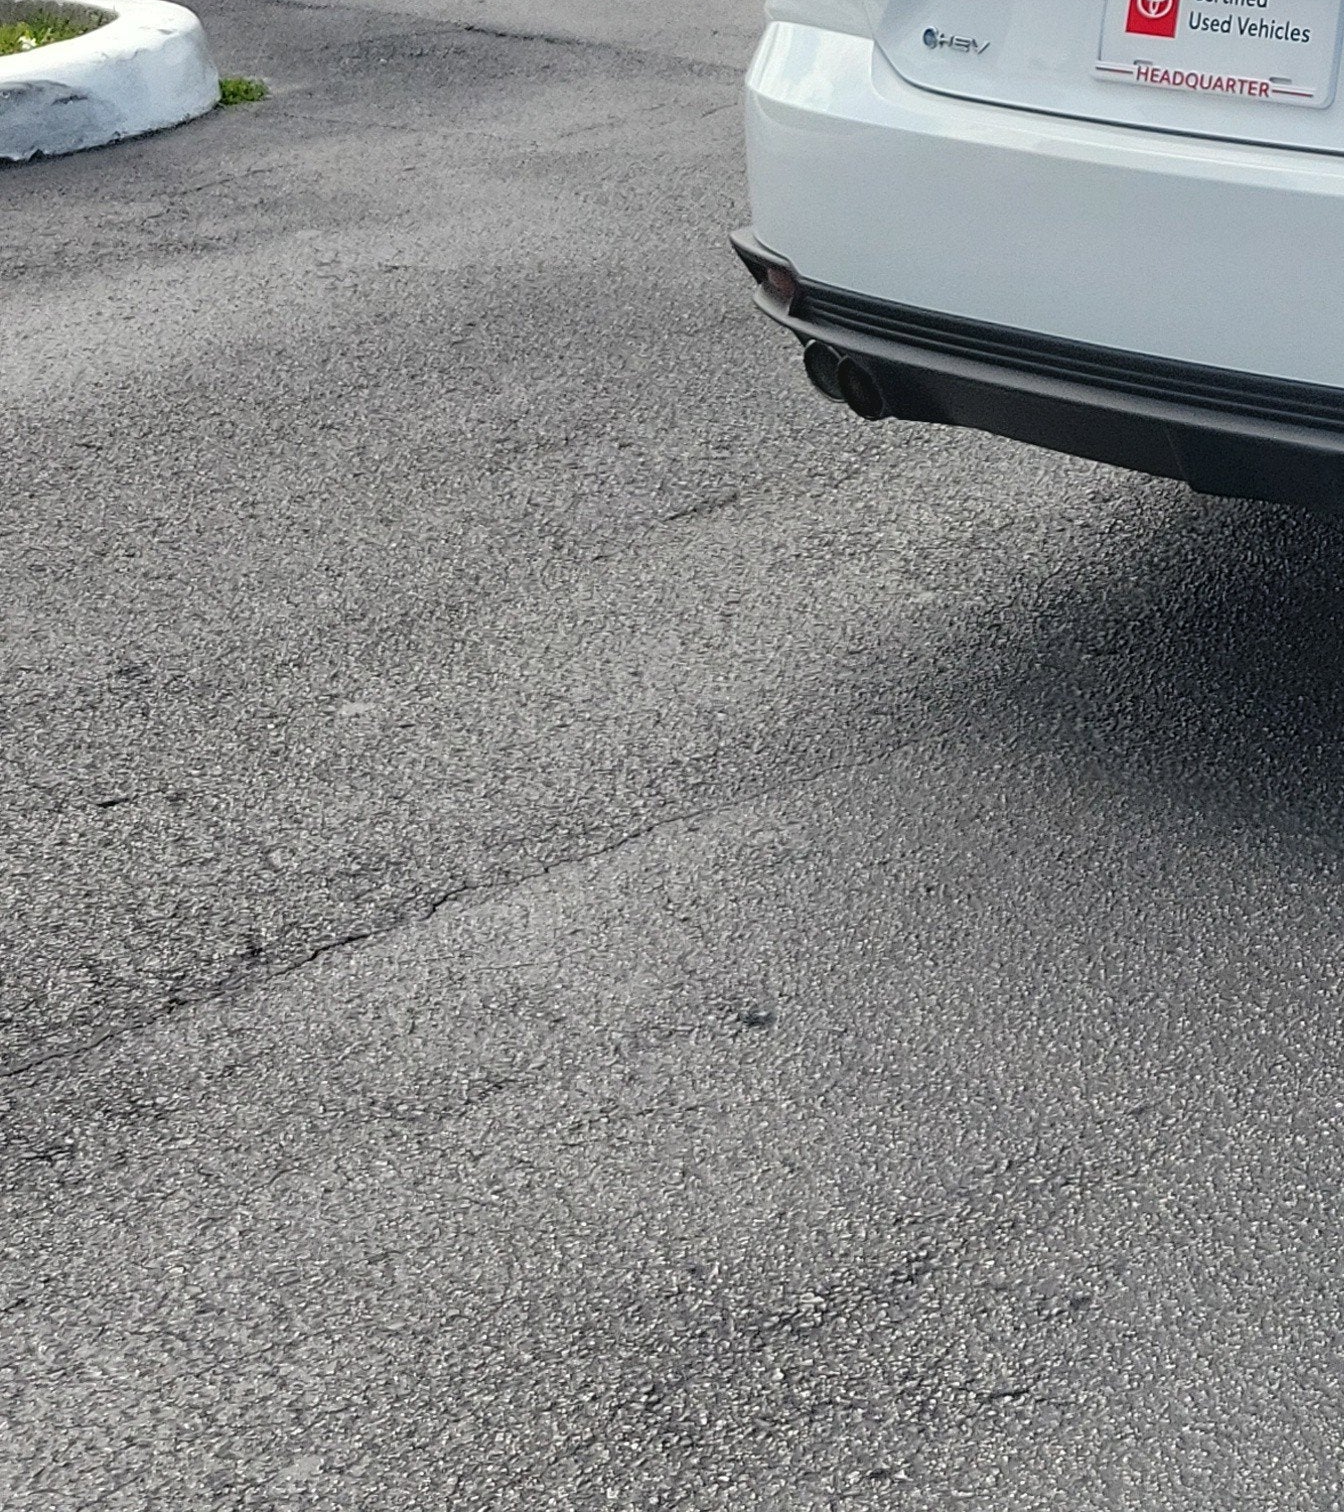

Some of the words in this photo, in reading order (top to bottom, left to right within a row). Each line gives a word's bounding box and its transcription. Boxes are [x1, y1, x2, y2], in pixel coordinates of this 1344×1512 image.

[1188, 10, 1233, 34] Used
[1237, 16, 1311, 43] Vehicles
[1136, 65, 1270, 98] HEADQUARTER
